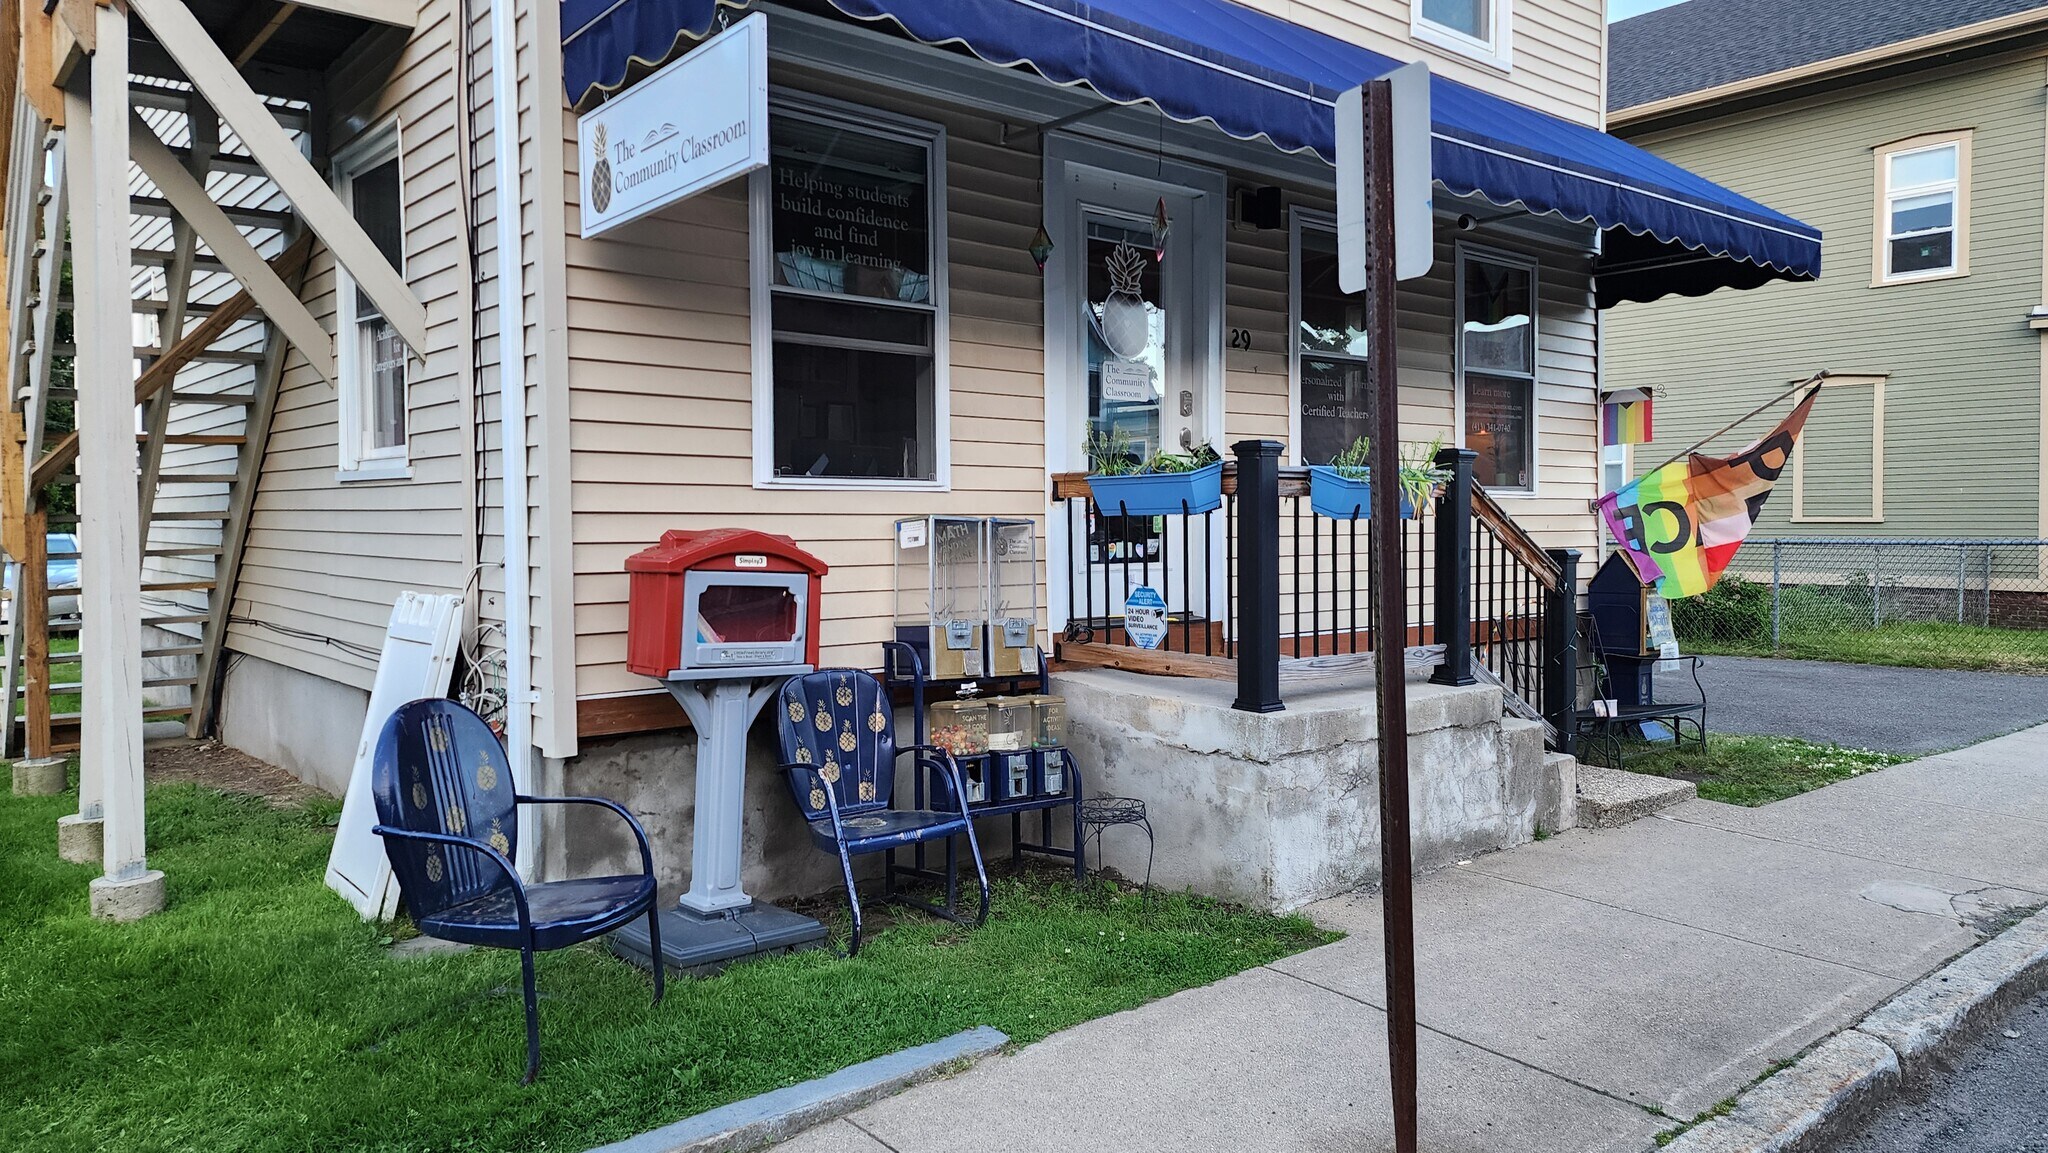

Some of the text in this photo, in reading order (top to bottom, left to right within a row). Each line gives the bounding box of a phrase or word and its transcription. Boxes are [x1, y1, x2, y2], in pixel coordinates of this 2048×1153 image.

[614, 139, 635, 165] The
[615, 120, 746, 194] Community Classroom
[780, 168, 909, 208] Helping students
[781, 193, 909, 231] build confidence
[815, 224, 878, 246] and find
[821, 243, 836, 260] in
[1232, 329, 1251, 351] 29
[1106, 364, 1120, 374] The
[1106, 375, 1146, 388] Community
[1301, 375, 1342, 387] ersonalized
[1106, 387, 1142, 398] Classroom
[1328, 390, 1344, 401] with
[1472, 384, 1511, 398] Learn more
[1302, 404, 1369, 419] Certified Teachers
[936, 522, 969, 543] MATH
[1135, 608, 1149, 616] HOUR
[1128, 622, 1158, 630] SURVEILLANCE
